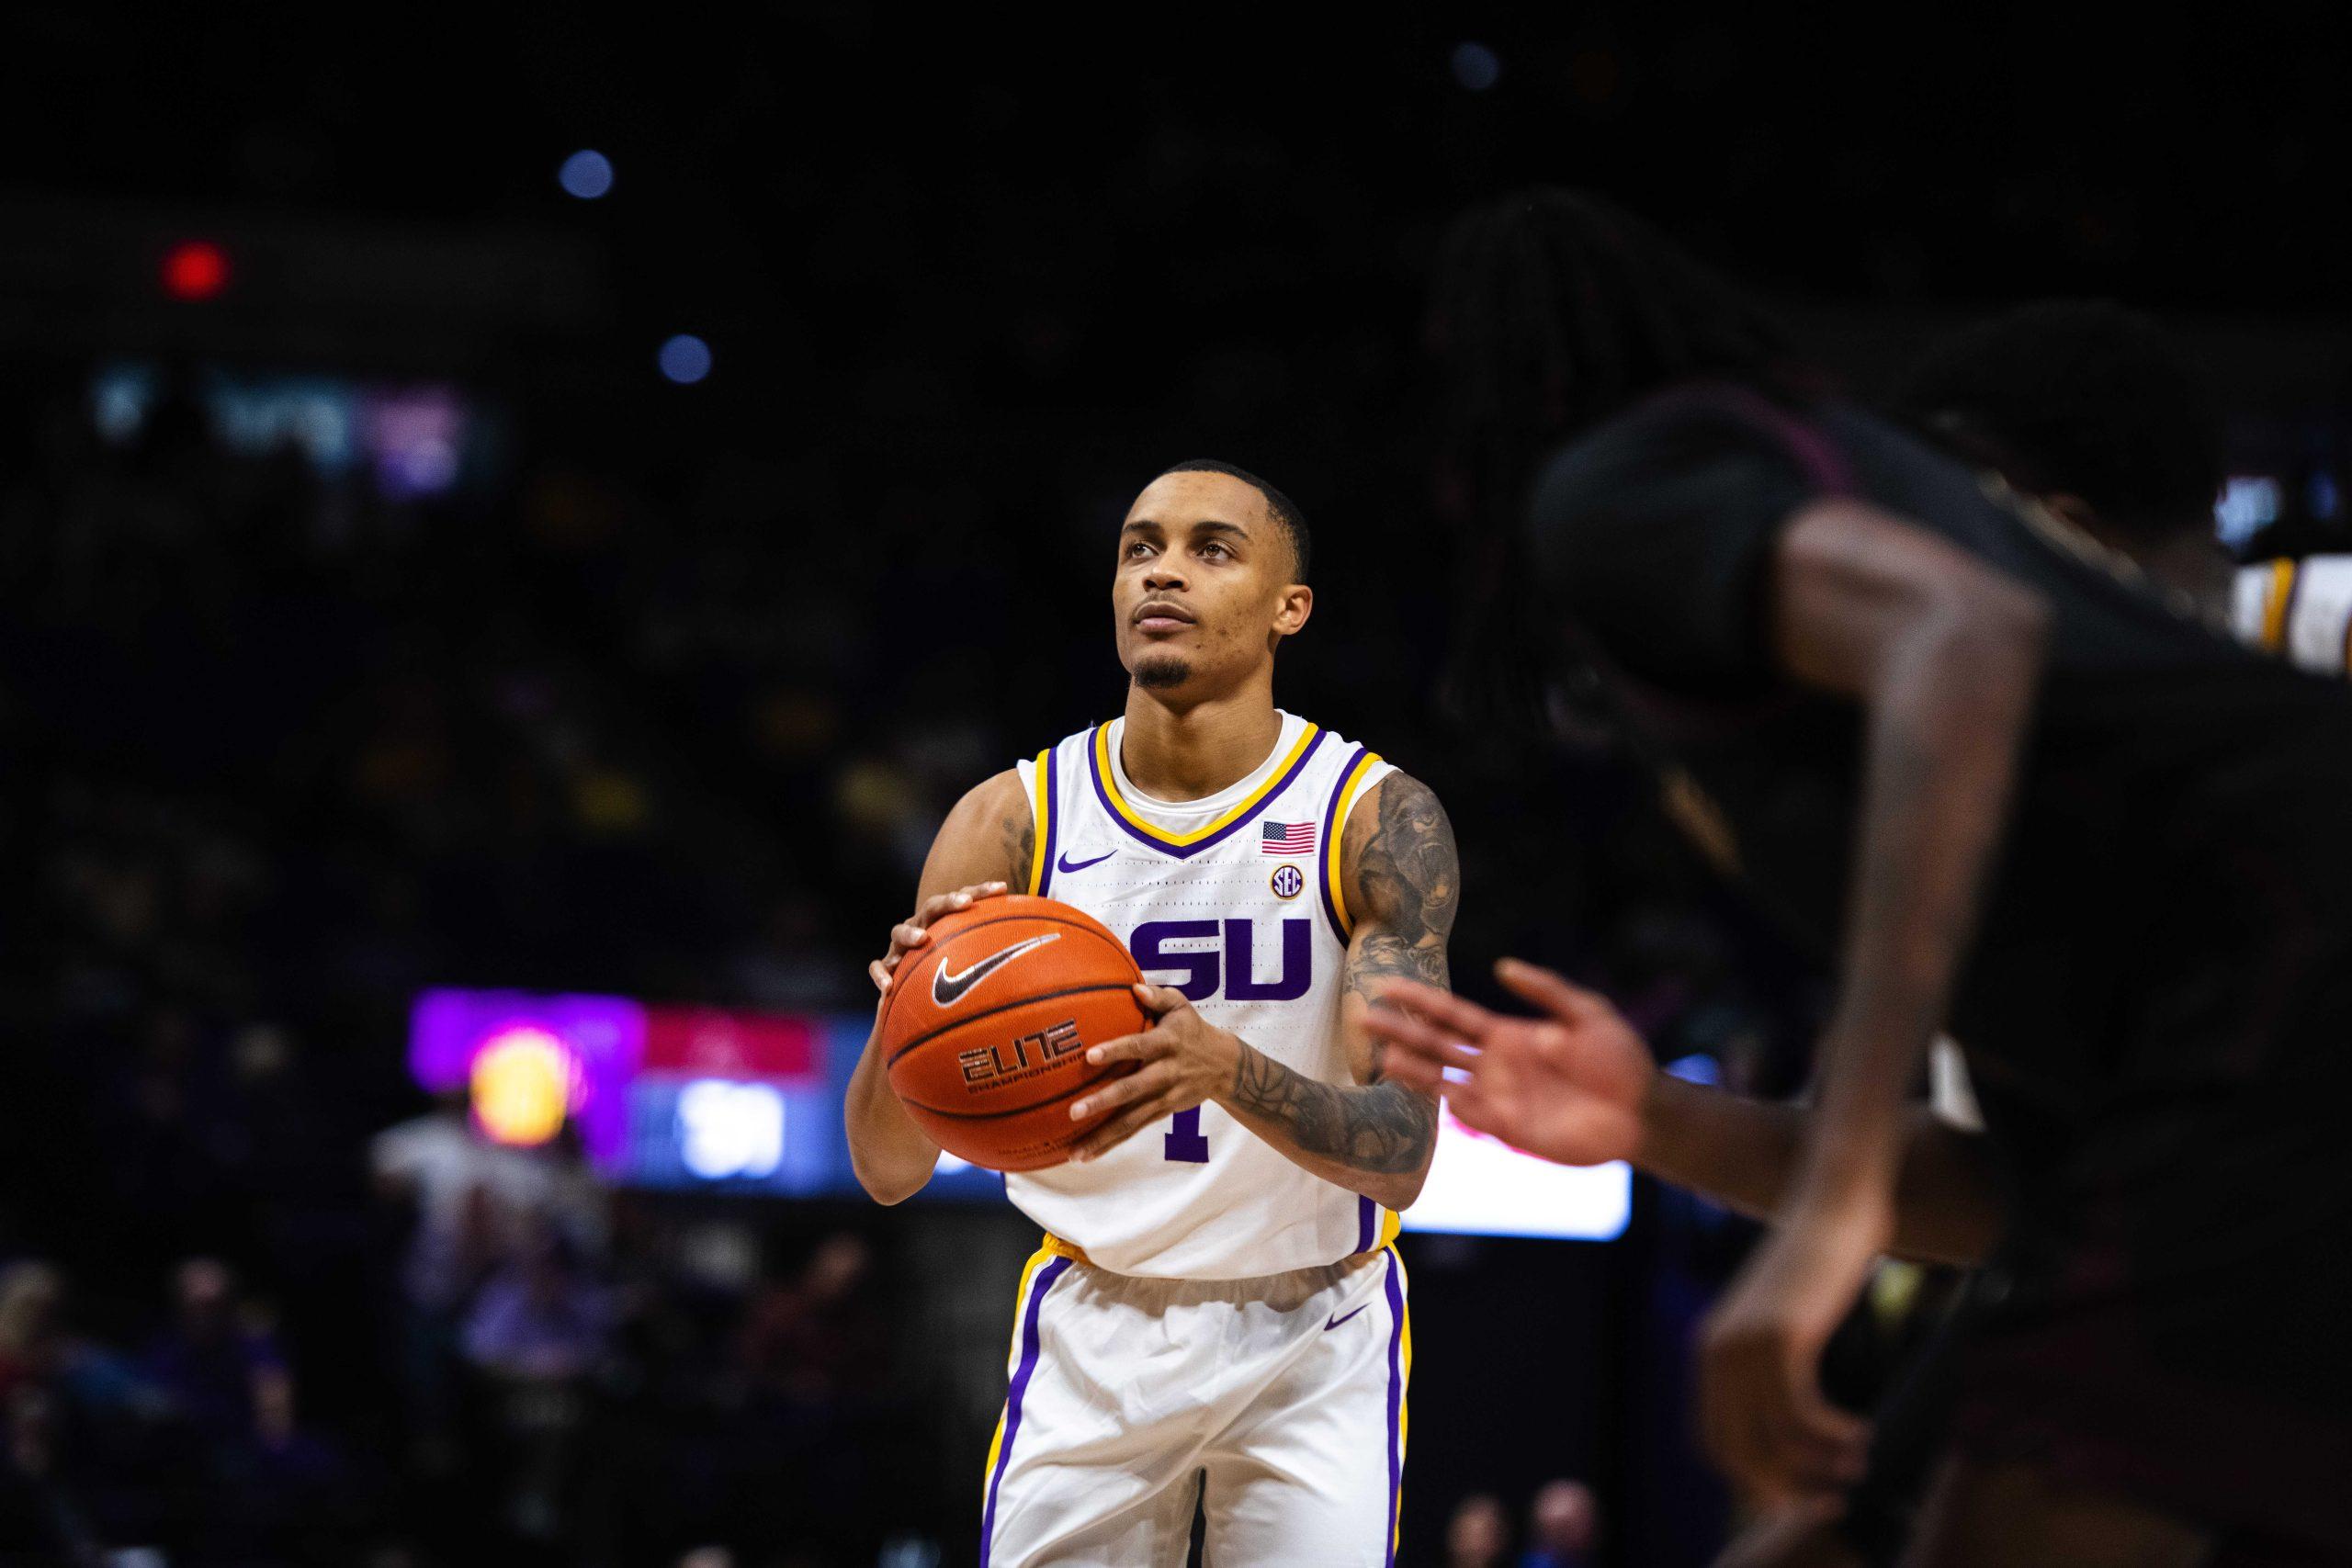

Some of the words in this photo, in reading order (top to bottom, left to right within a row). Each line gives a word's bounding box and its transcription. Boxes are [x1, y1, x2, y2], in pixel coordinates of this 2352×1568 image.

[1273, 866, 1302, 897] SEC
[1130, 919, 1311, 1000] SU
[959, 1018, 1082, 1085] ELITE
